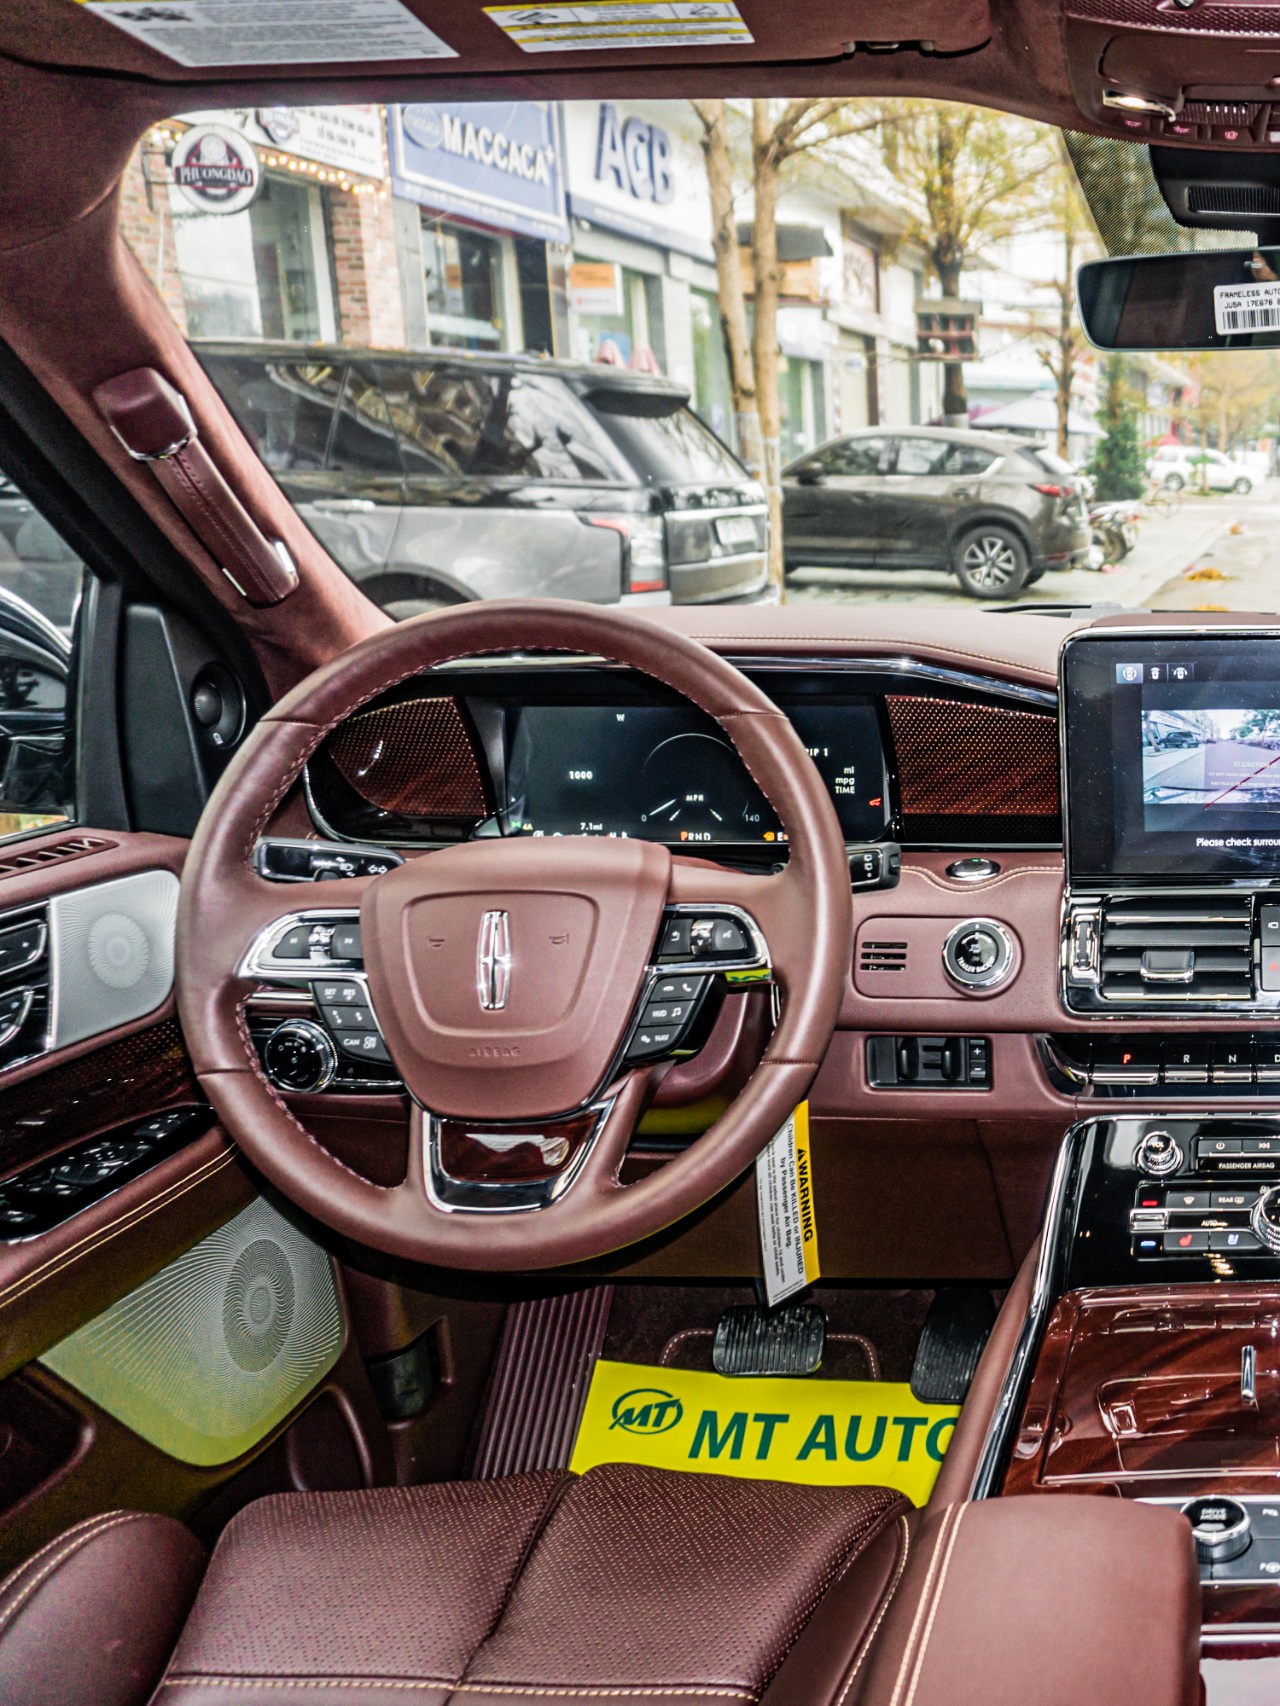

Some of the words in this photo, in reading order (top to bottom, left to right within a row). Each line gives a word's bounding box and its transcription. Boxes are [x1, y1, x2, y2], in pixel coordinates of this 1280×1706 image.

[1220, 289, 1261, 299] FRAMELESS
[1224, 301, 1242, 309] JU5A
[616, 713, 625, 722] W
[569, 770, 594, 780] 1000
[835, 777, 855, 786] mpg
[835, 786, 855, 794] TIME
[685, 794, 704, 802] MPH
[641, 814, 647, 823] 0
[744, 814, 760, 823] 140
[1196, 837, 1224, 847] Please
[1225, 837, 1252, 847] check
[324, 988, 337, 996] SET
[652, 1009, 668, 1018] HUD
[344, 1038, 360, 1046] CAN
[655, 1033, 669, 1042] NAV
[1123, 1053, 1131, 1064] P
[1183, 1053, 1191, 1063] R
[1228, 1053, 1237, 1063] N
[787, 1124, 795, 1159] Children
[780, 1157, 787, 1168] by
[789, 1179, 796, 1191] Be
[781, 1169, 790, 1214] Passenger
[798, 1160, 813, 1243] WARNING
[791, 1193, 799, 1224] KILLED
[793, 1225, 799, 1235] or
[795, 1236, 804, 1274] INJURED
[608, 1398, 681, 1431] MT
[688, 1409, 790, 1461] MT
[1201, 1507, 1227, 1515] DRIVE
